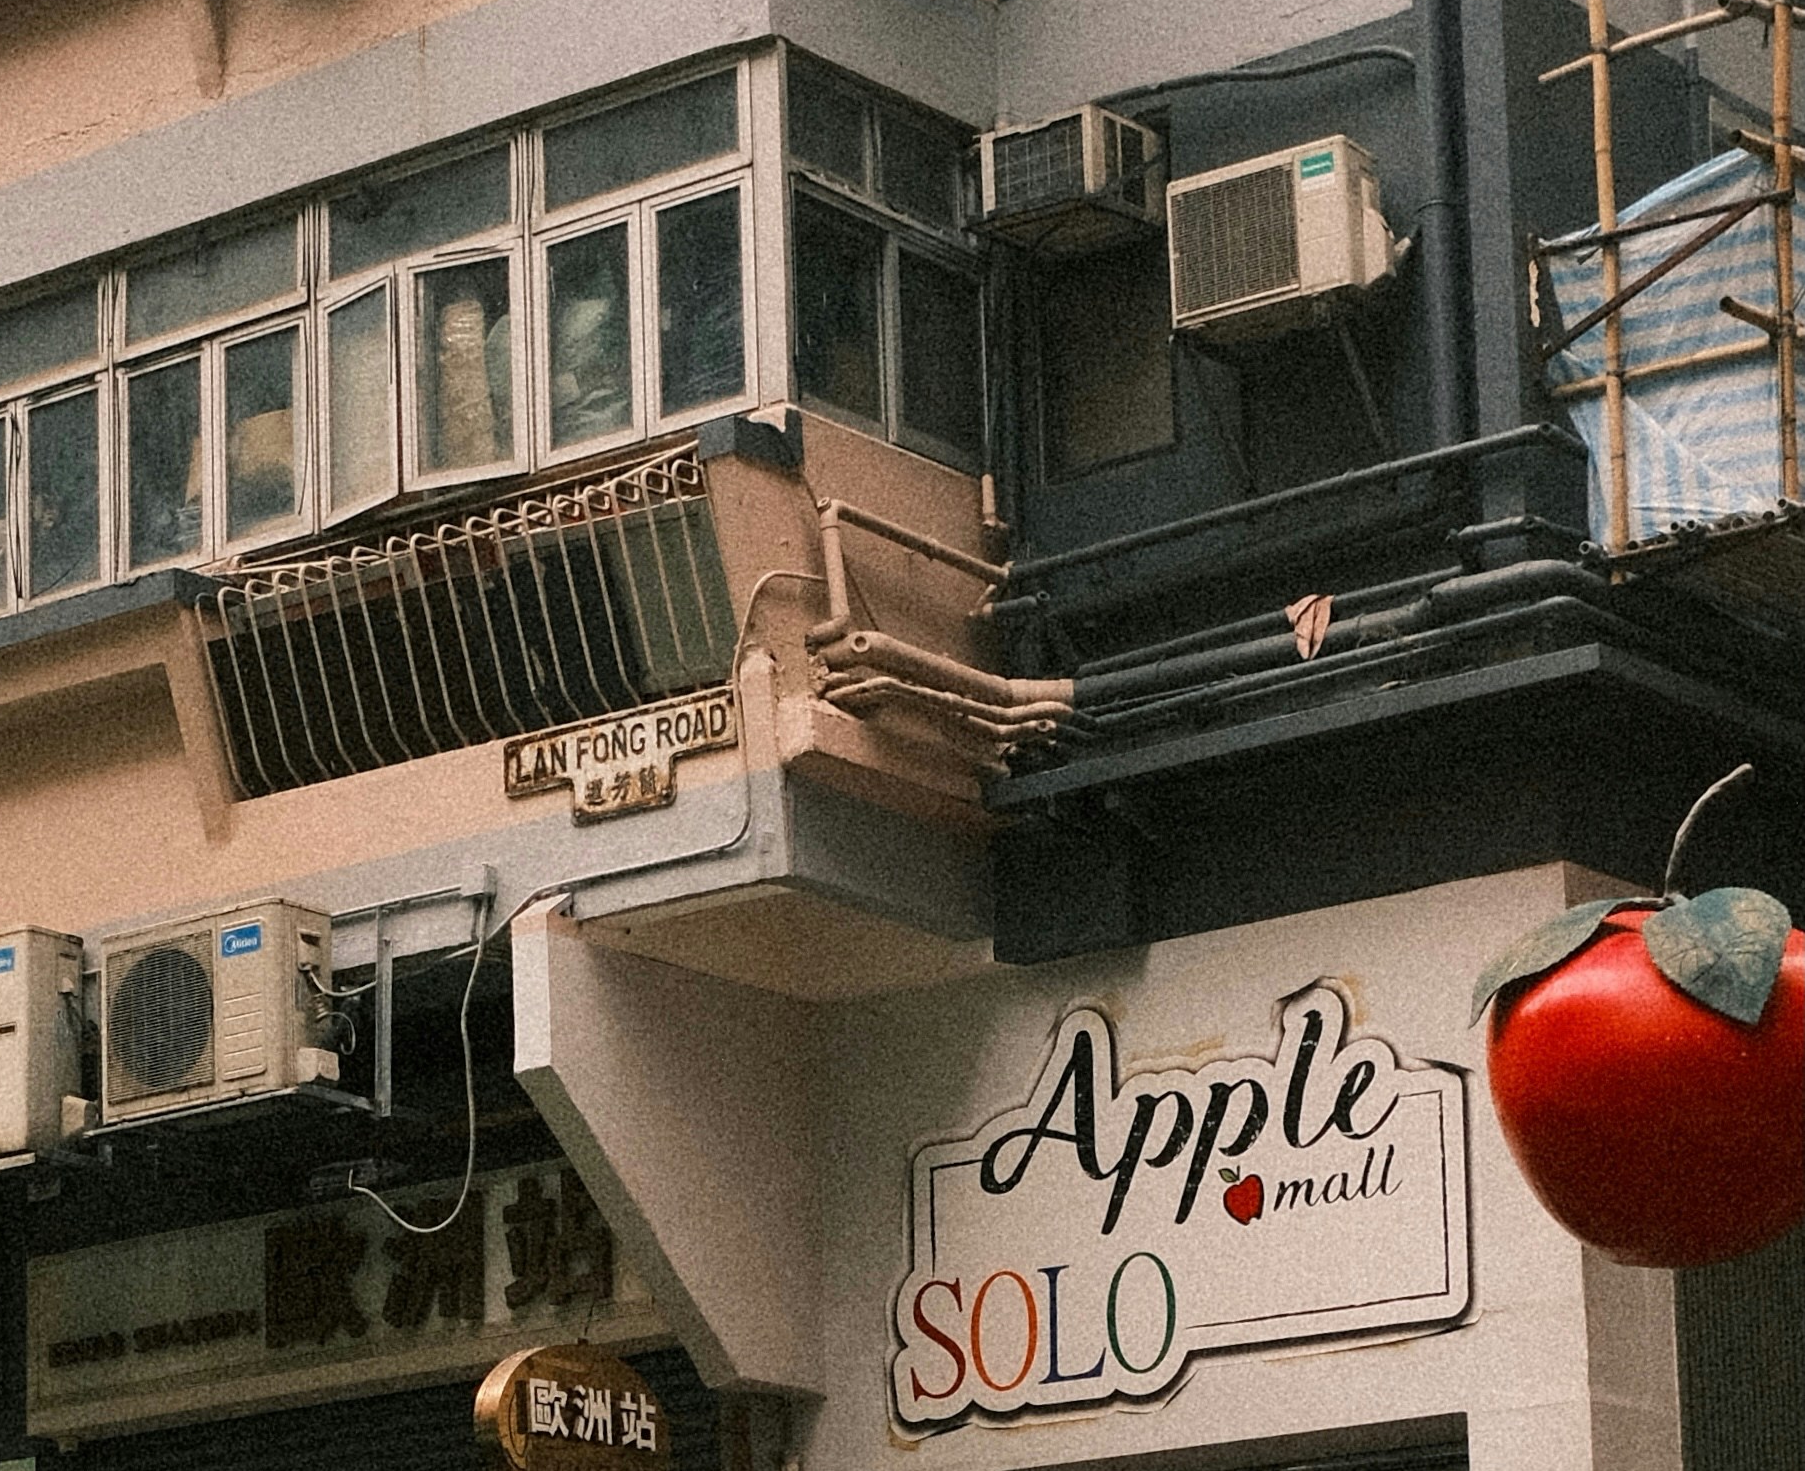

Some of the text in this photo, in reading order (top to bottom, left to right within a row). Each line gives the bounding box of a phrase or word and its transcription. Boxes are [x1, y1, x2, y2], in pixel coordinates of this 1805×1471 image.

[516, 703, 727, 783] LAN FONG ROAD
[980, 1010, 1400, 1235] Apple
[1273, 1144, 1402, 1212] mall
[910, 1252, 1177, 1403] SOLO
[527, 1378, 658, 1452] 歐洲站
